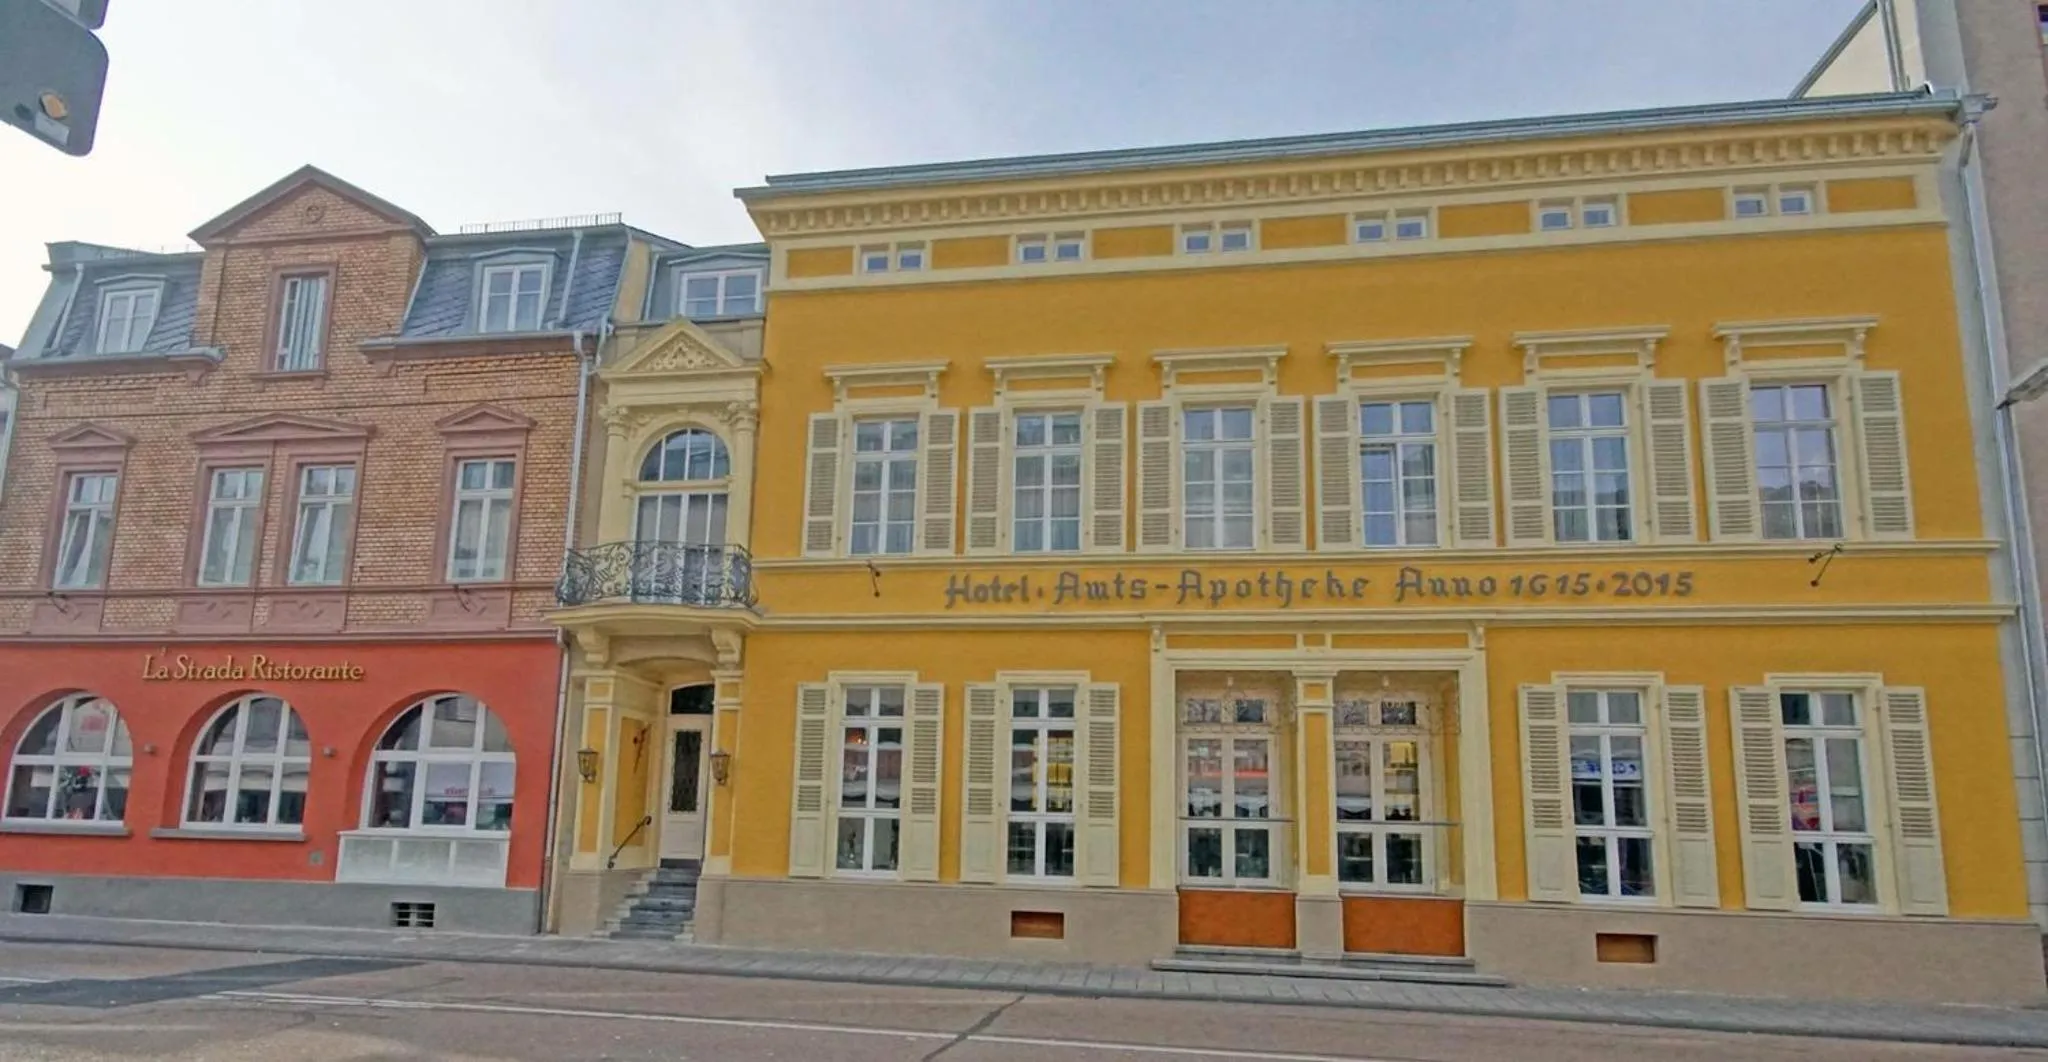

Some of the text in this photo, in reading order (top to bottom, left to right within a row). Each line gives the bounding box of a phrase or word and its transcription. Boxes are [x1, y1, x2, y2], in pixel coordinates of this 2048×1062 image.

[1394, 565, 1498, 604] Anno
[174, 654, 244, 679] Strada
[251, 653, 364, 680] Ristorante
